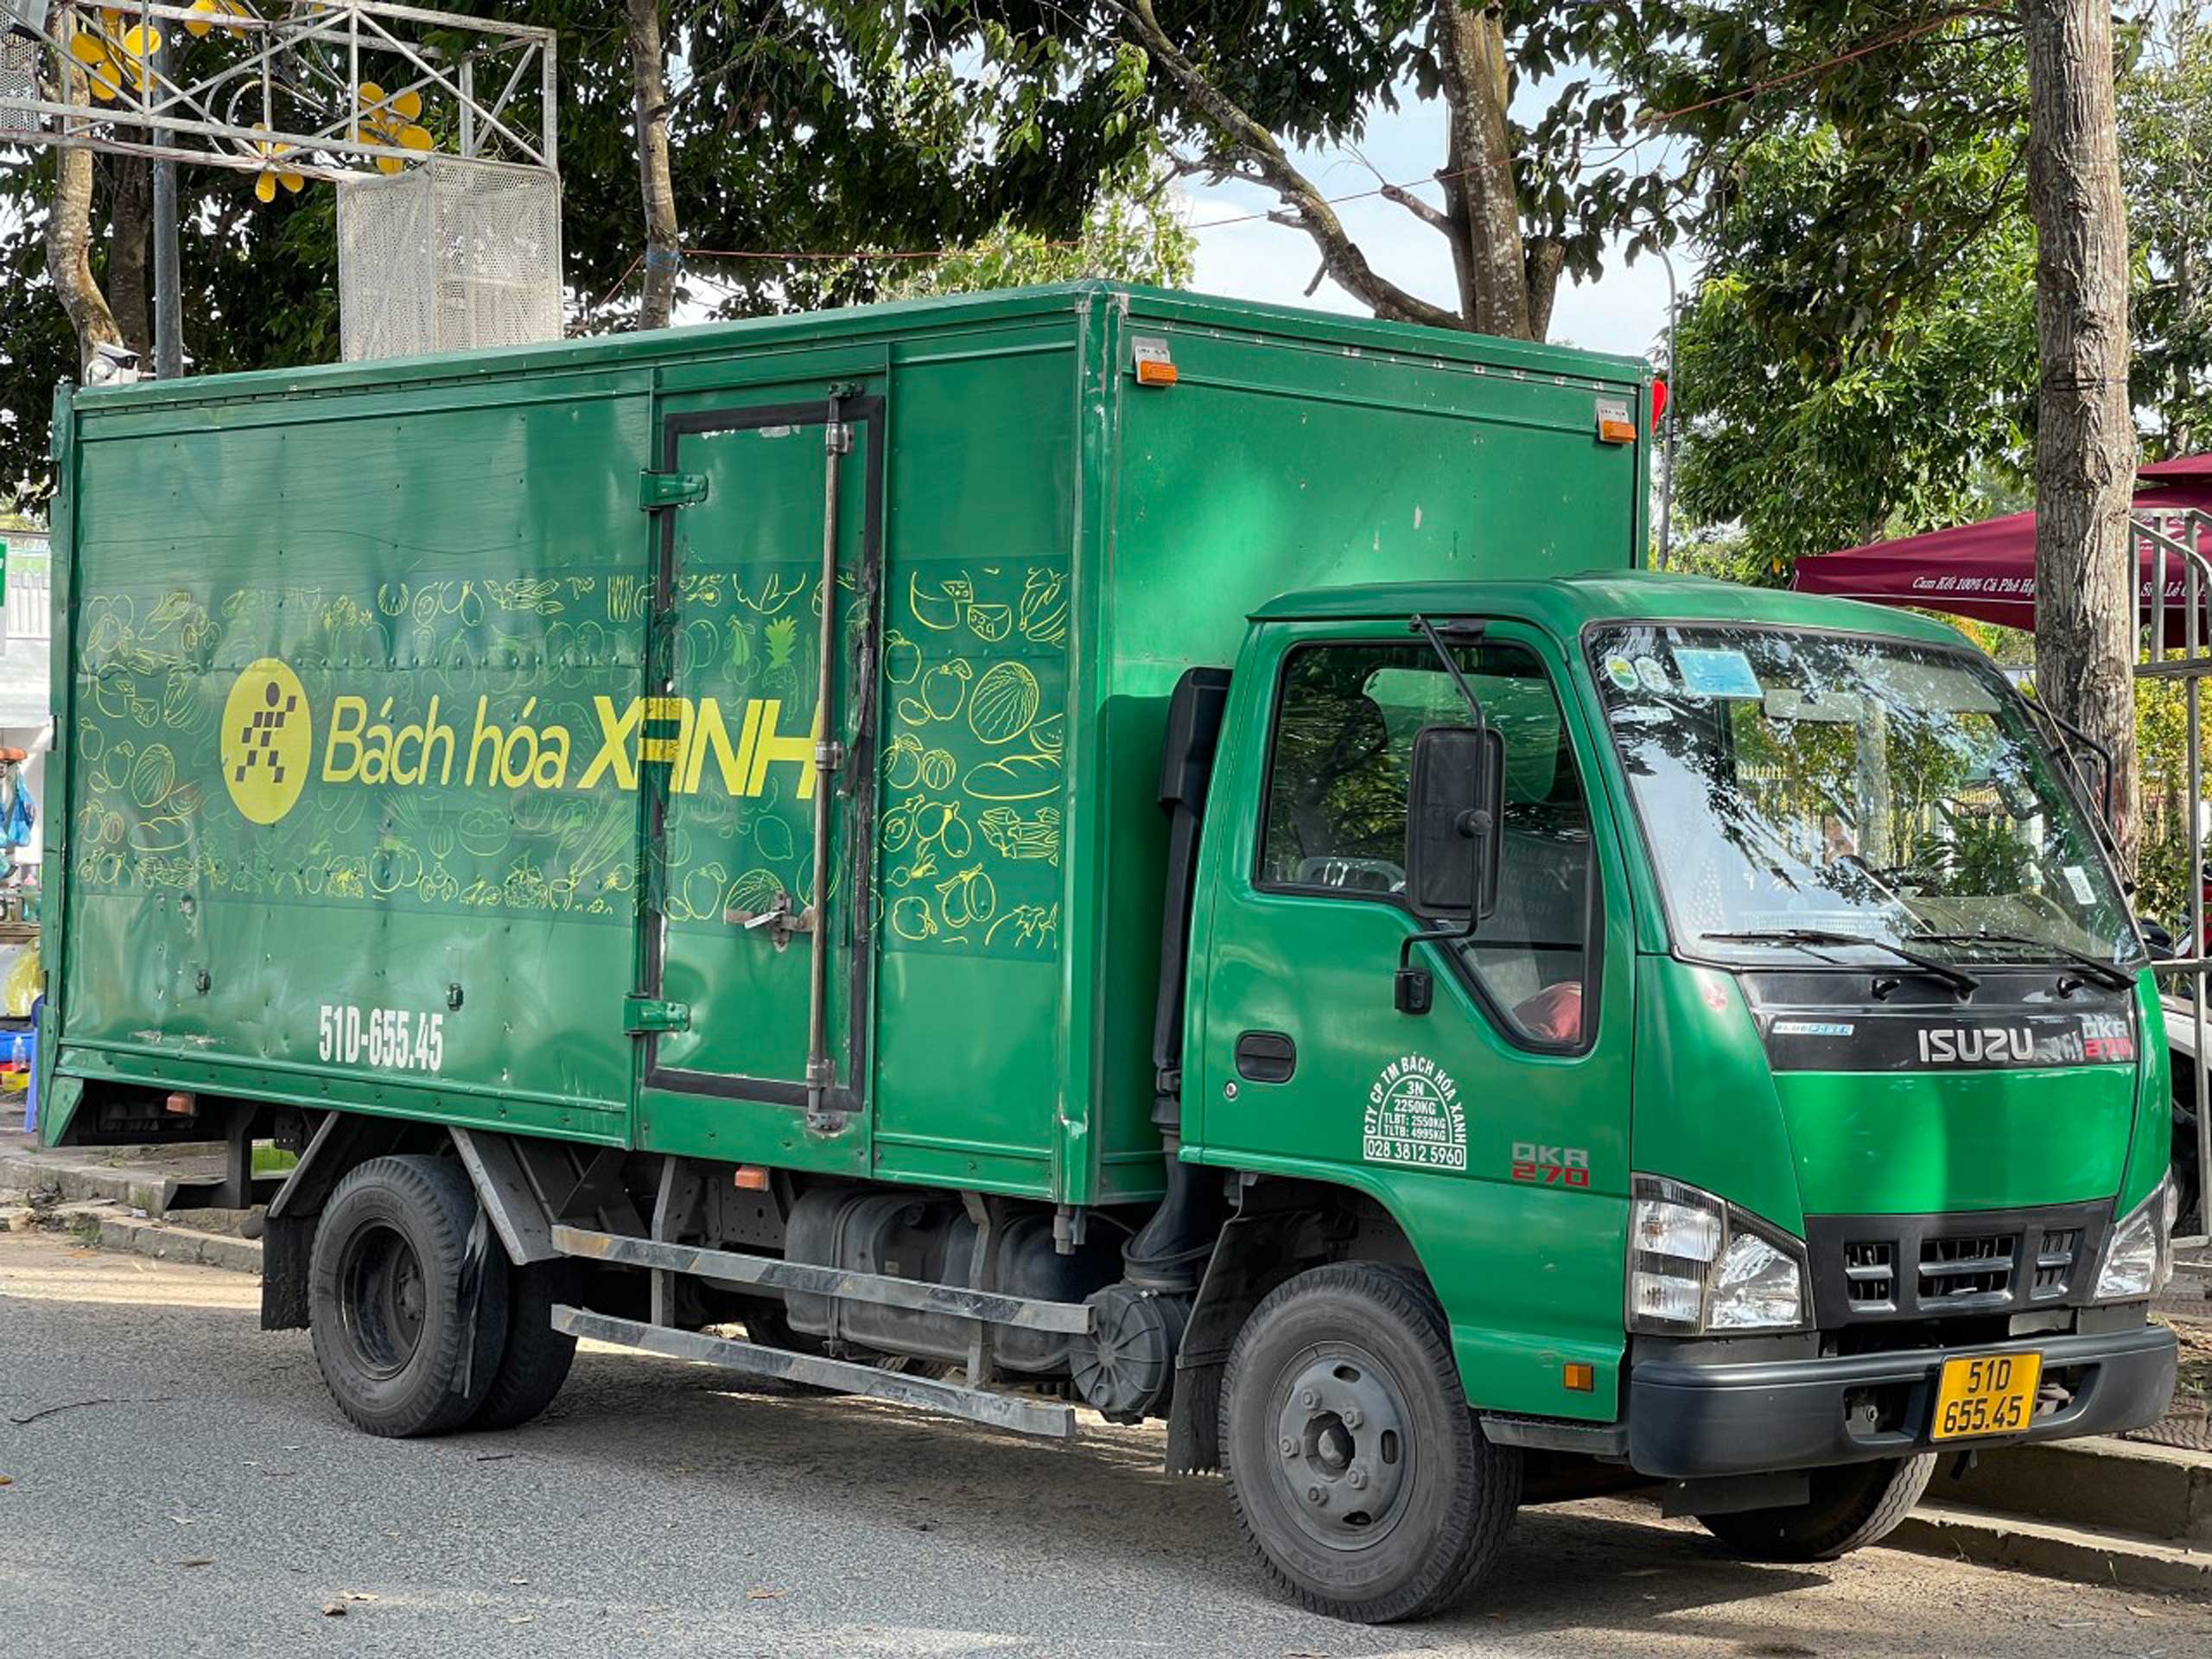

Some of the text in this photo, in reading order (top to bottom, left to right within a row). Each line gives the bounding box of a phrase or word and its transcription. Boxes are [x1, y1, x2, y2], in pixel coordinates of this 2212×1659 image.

[321, 695, 823, 799] Bách hóa XANH
[318, 1005, 444, 1072] 51D-655.45
[1917, 1028, 2034, 1063] ISUZU
[1380, 1062, 1401, 1085] TM
[1370, 1082, 1384, 1104] CP
[1406, 1080, 1425, 1096] 3N
[1364, 1104, 1378, 1135] CTY
[1383, 1111, 1409, 1127] TLBT:
[1394, 1098, 1437, 1116] 2250KG
[1383, 1123, 1409, 1138] TLTB:
[1450, 1102, 1466, 1143] XANH
[1368, 1140, 1464, 1166] 028 3812 5960
[1512, 1161, 1591, 1189] 270
[1967, 1359, 2012, 1394] 51D
[1943, 1395, 2024, 1433] 655.45
